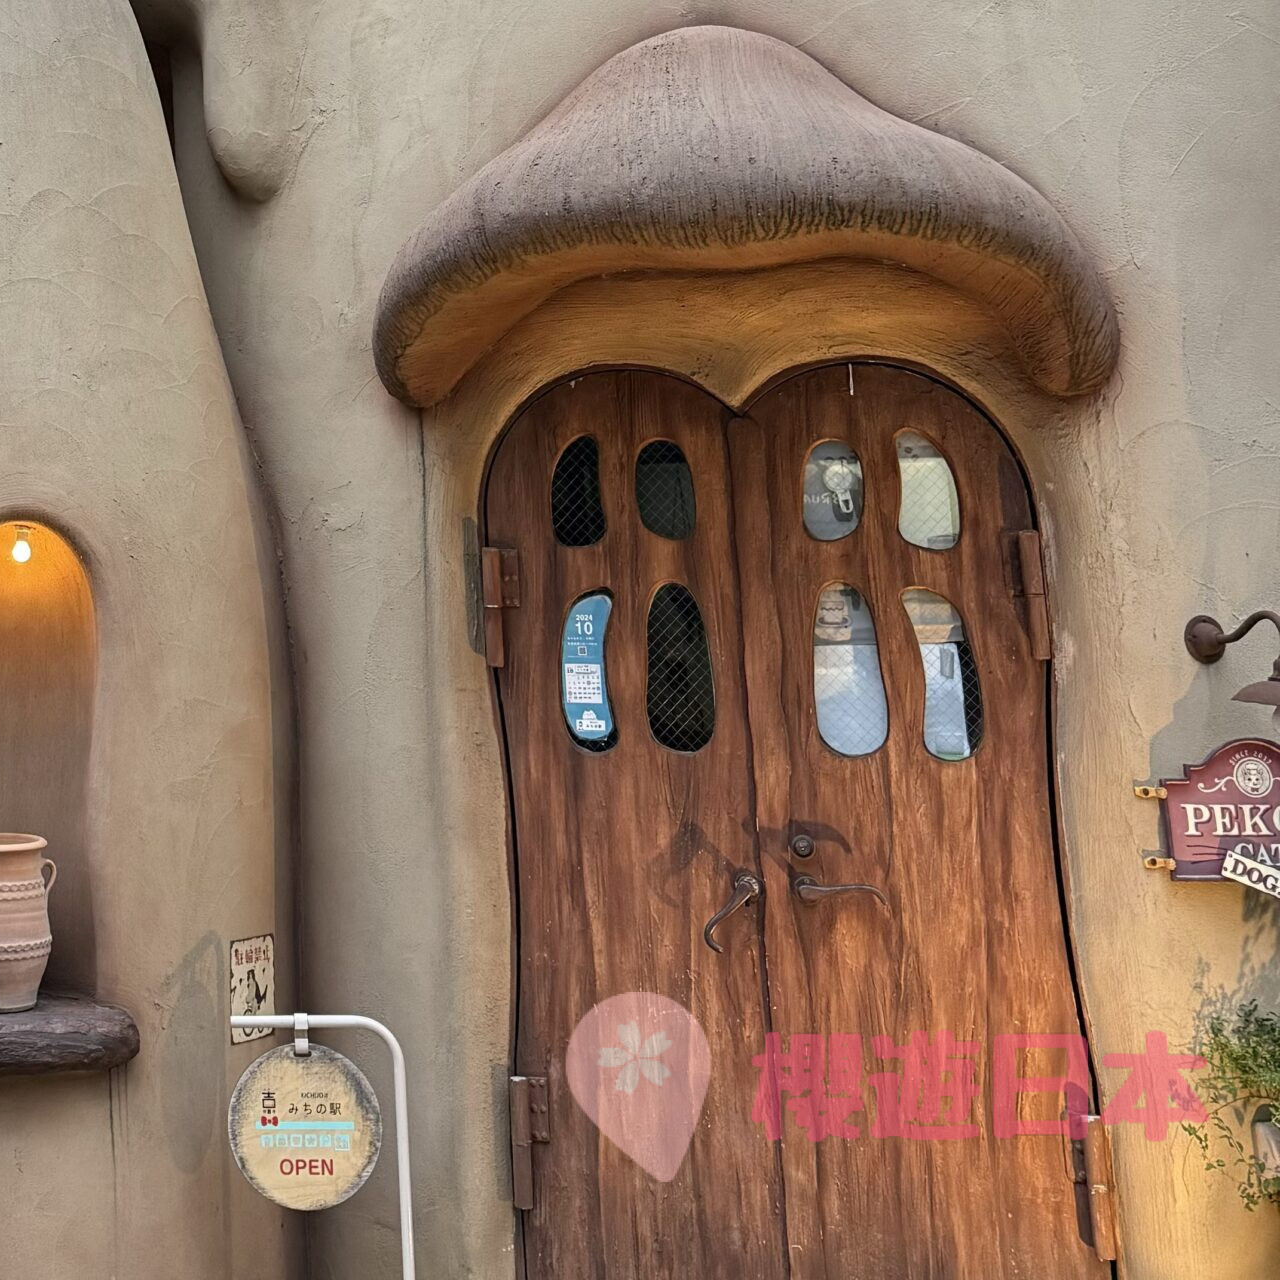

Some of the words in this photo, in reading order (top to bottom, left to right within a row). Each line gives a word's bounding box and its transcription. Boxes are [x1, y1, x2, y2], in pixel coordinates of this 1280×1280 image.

[575, 621, 593, 635] 10
[288, 1102, 342, 1116] みちの駅
[279, 1158, 334, 1176] OPEN
